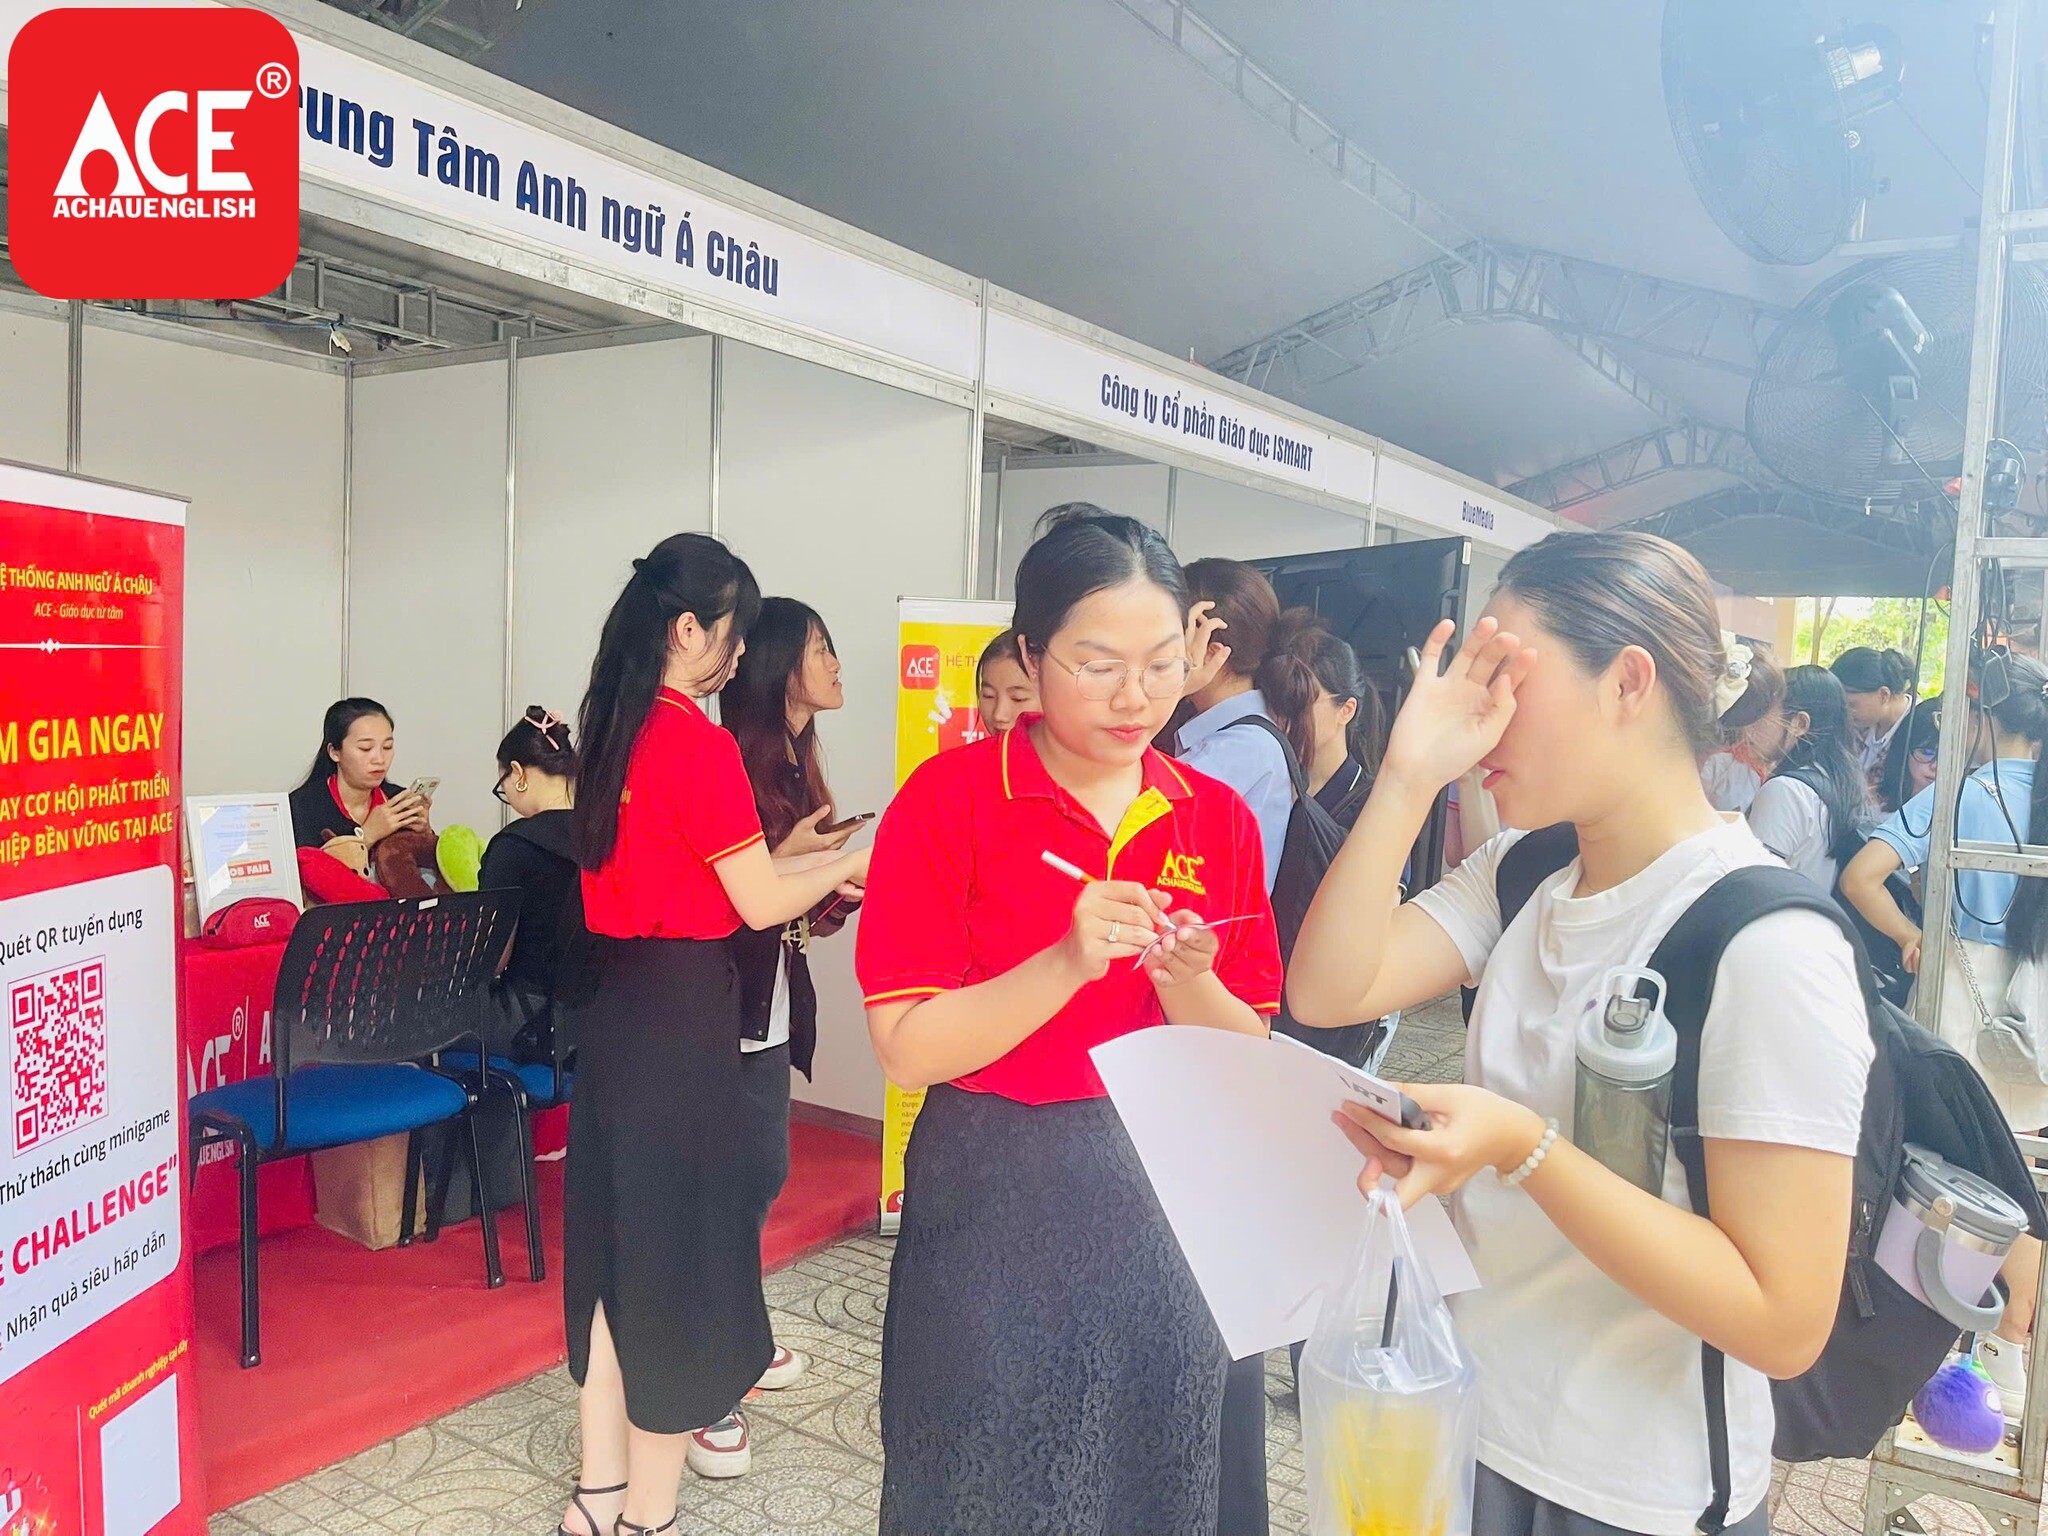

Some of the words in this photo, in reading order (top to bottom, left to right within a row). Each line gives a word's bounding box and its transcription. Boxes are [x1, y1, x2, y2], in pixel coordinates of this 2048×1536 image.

[413, 118, 500, 201] Tâm
[516, 160, 587, 231] Anh
[601, 196, 665, 258] ngữ
[676, 211, 695, 268] Á
[707, 231, 779, 297] Châu
[1101, 373, 1139, 418] Công
[1144, 388, 1158, 424] ty
[1162, 390, 1181, 429] Cổ
[1183, 400, 1215, 441] phần
[1218, 415, 1246, 450] Giáo
[1249, 427, 1270, 462] dục
[1273, 434, 1313, 472] ISMART
[9, 564, 55, 589] THỐNG
[57, 571, 83, 591] ANH
[85, 571, 112, 593] NGỮ
[113, 572, 122, 593] Á
[123, 574, 153, 595] CHÂU
[34, 602, 51, 617] ACE
[59, 603, 79, 618] Giáo
[80, 605, 95, 619] dục
[96, 606, 106, 619] từ
[107, 606, 124, 619] tâm
[905, 656, 935, 675] ACE
[946, 652, 963, 669] HỆ
[28, 718, 83, 761] GIA
[90, 712, 164, 755] NGAY
[25, 791, 51, 817] CƠ
[54, 783, 84, 816] HỘI
[89, 778, 128, 808] PHÁT
[132, 770, 170, 803] TRIỂN
[35, 825, 69, 857] BỀN
[73, 819, 120, 849] VỮNG
[124, 816, 147, 844] TẠI
[150, 811, 173, 834] ACE
[1161, 849, 1202, 886] ACE
[36, 927, 58, 953] QR
[62, 913, 104, 945] tuyển
[108, 909, 143, 934] dụng
[254, 914, 270, 926] ACE
[30, 1154, 70, 1189] thách
[74, 1143, 106, 1171] cùng
[109, 1109, 170, 1150] minigame
[7, 1305, 47, 1343] Nhận
[52, 1282, 78, 1317] quà
[82, 1269, 109, 1295] siêu
[114, 1245, 138, 1276] hấp
[142, 1230, 166, 1258] dẫn
